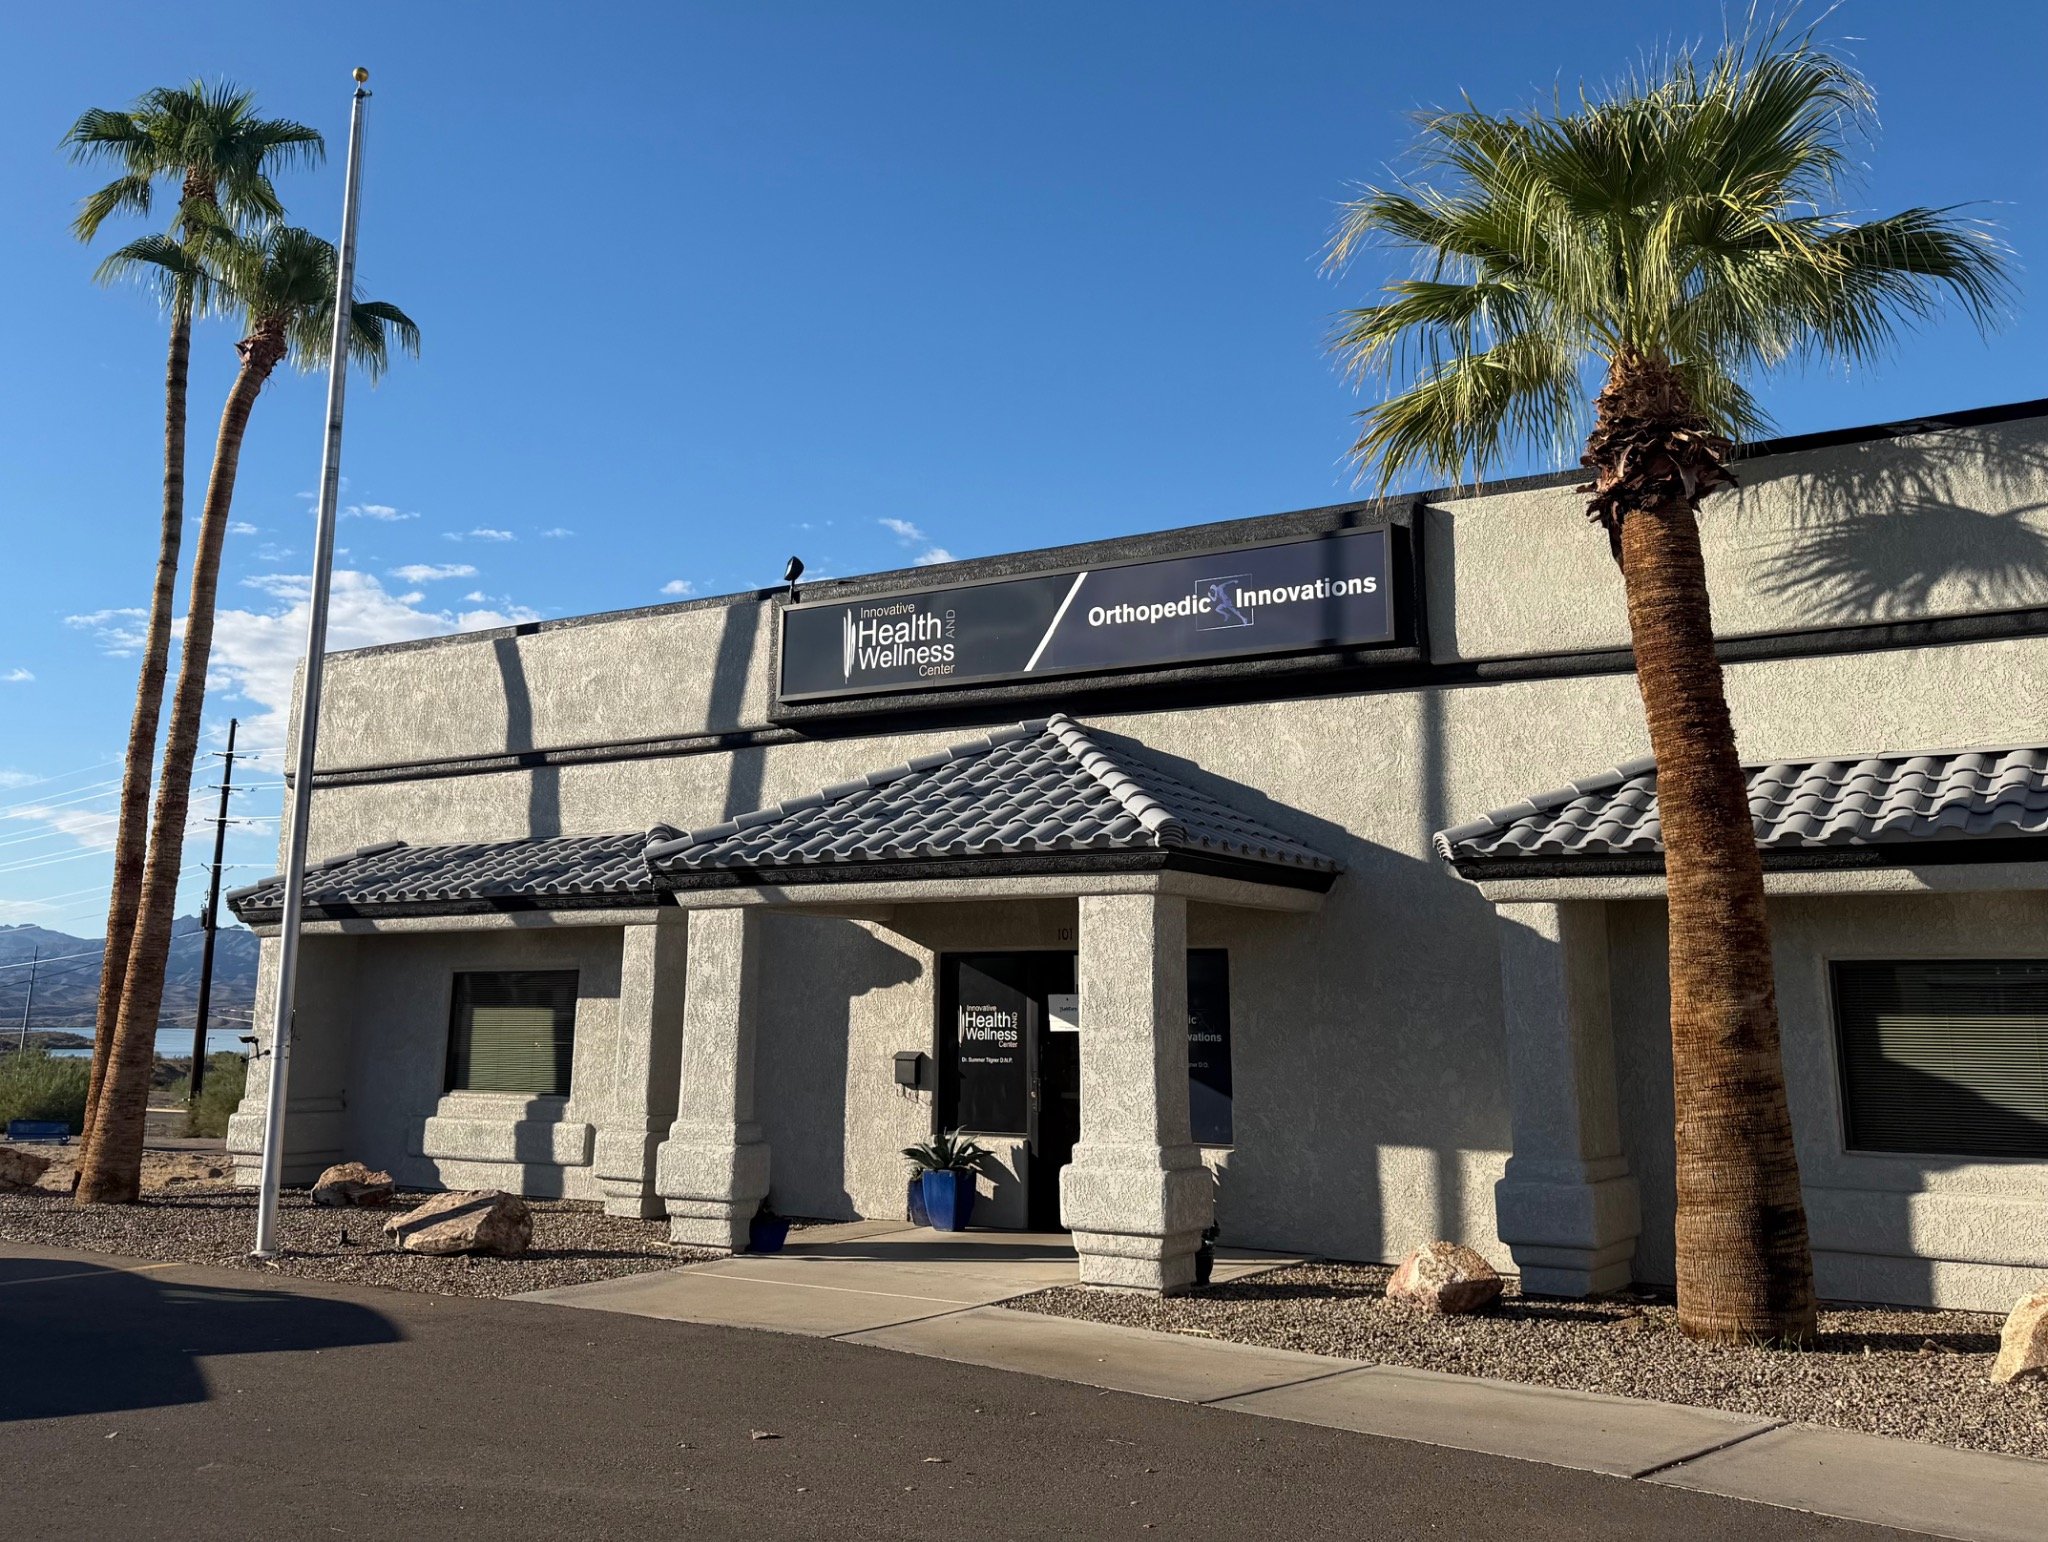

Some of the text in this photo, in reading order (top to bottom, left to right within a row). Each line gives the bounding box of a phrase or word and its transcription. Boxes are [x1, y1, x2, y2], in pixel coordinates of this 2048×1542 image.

[1088, 575, 1378, 627] Orthopedic Innovations
[860, 602, 916, 619] Innovative
[858, 611, 942, 648] Health
[945, 609, 956, 639] AND
[858, 643, 955, 671] Wellness
[918, 663, 956, 677] Center
[1057, 928, 1073, 941] 101
[966, 1004, 998, 1012] Innovative
[965, 1011, 1011, 1028] Health
[965, 1027, 1018, 1041] Wellness
[998, 1040, 1018, 1048] Center
